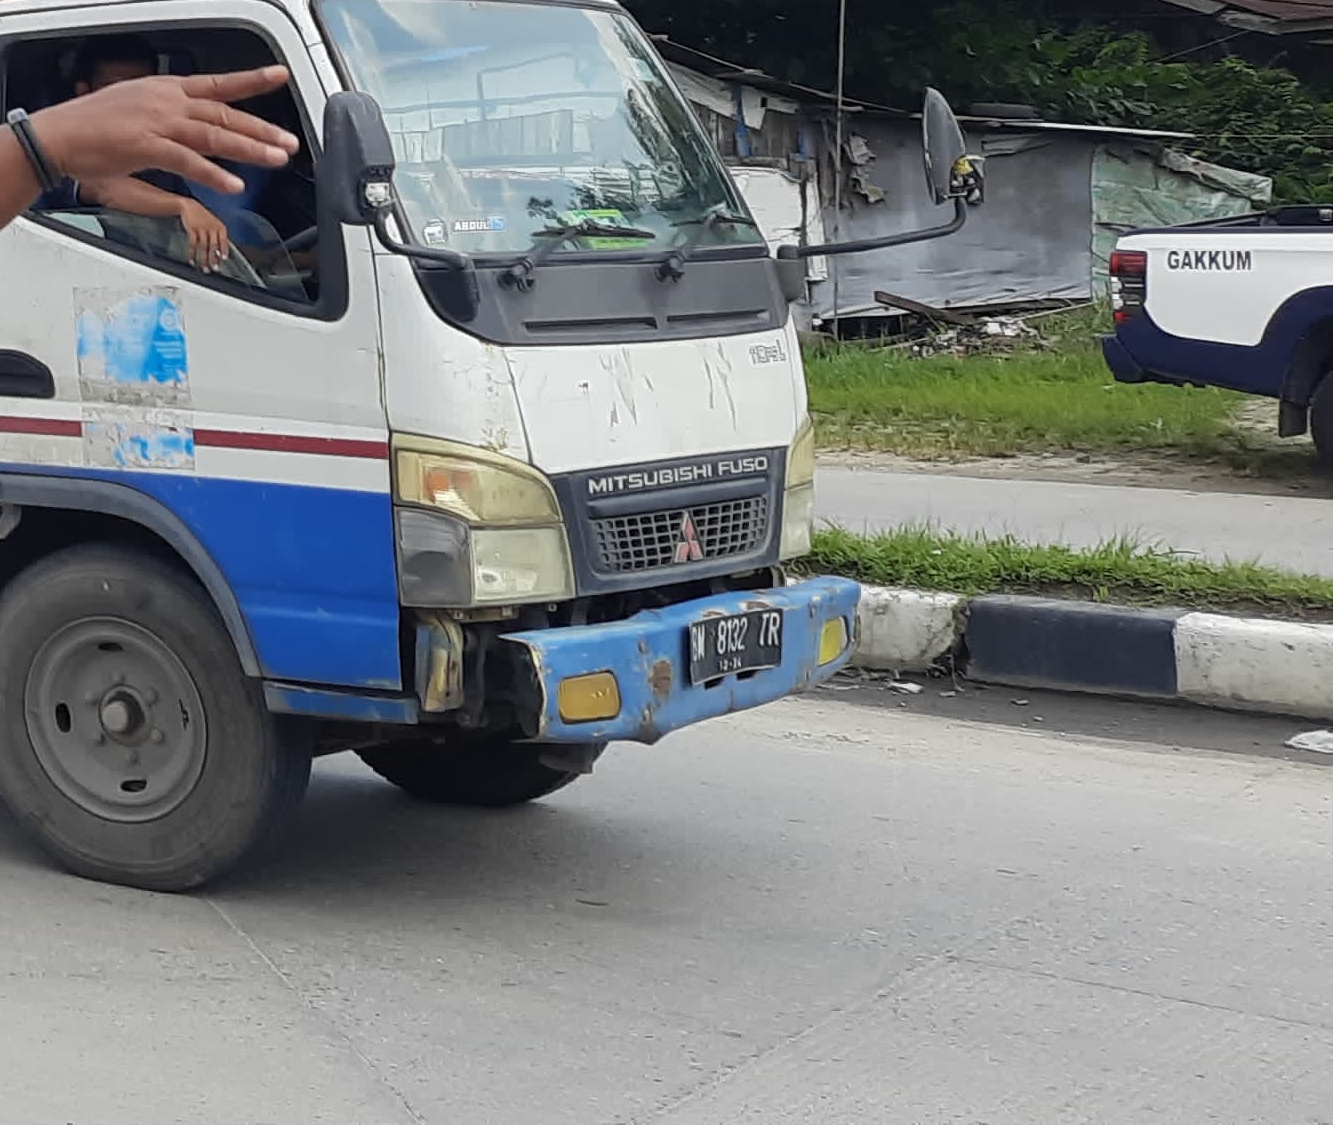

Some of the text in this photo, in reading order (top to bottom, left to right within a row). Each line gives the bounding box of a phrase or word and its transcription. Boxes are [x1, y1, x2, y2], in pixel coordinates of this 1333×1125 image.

[1167, 250, 1252, 271] GAKKUM
[588, 456, 768, 494] MITSUBISHI FUSO
[717, 617, 748, 655] 8132
[759, 612, 780, 646] TR
